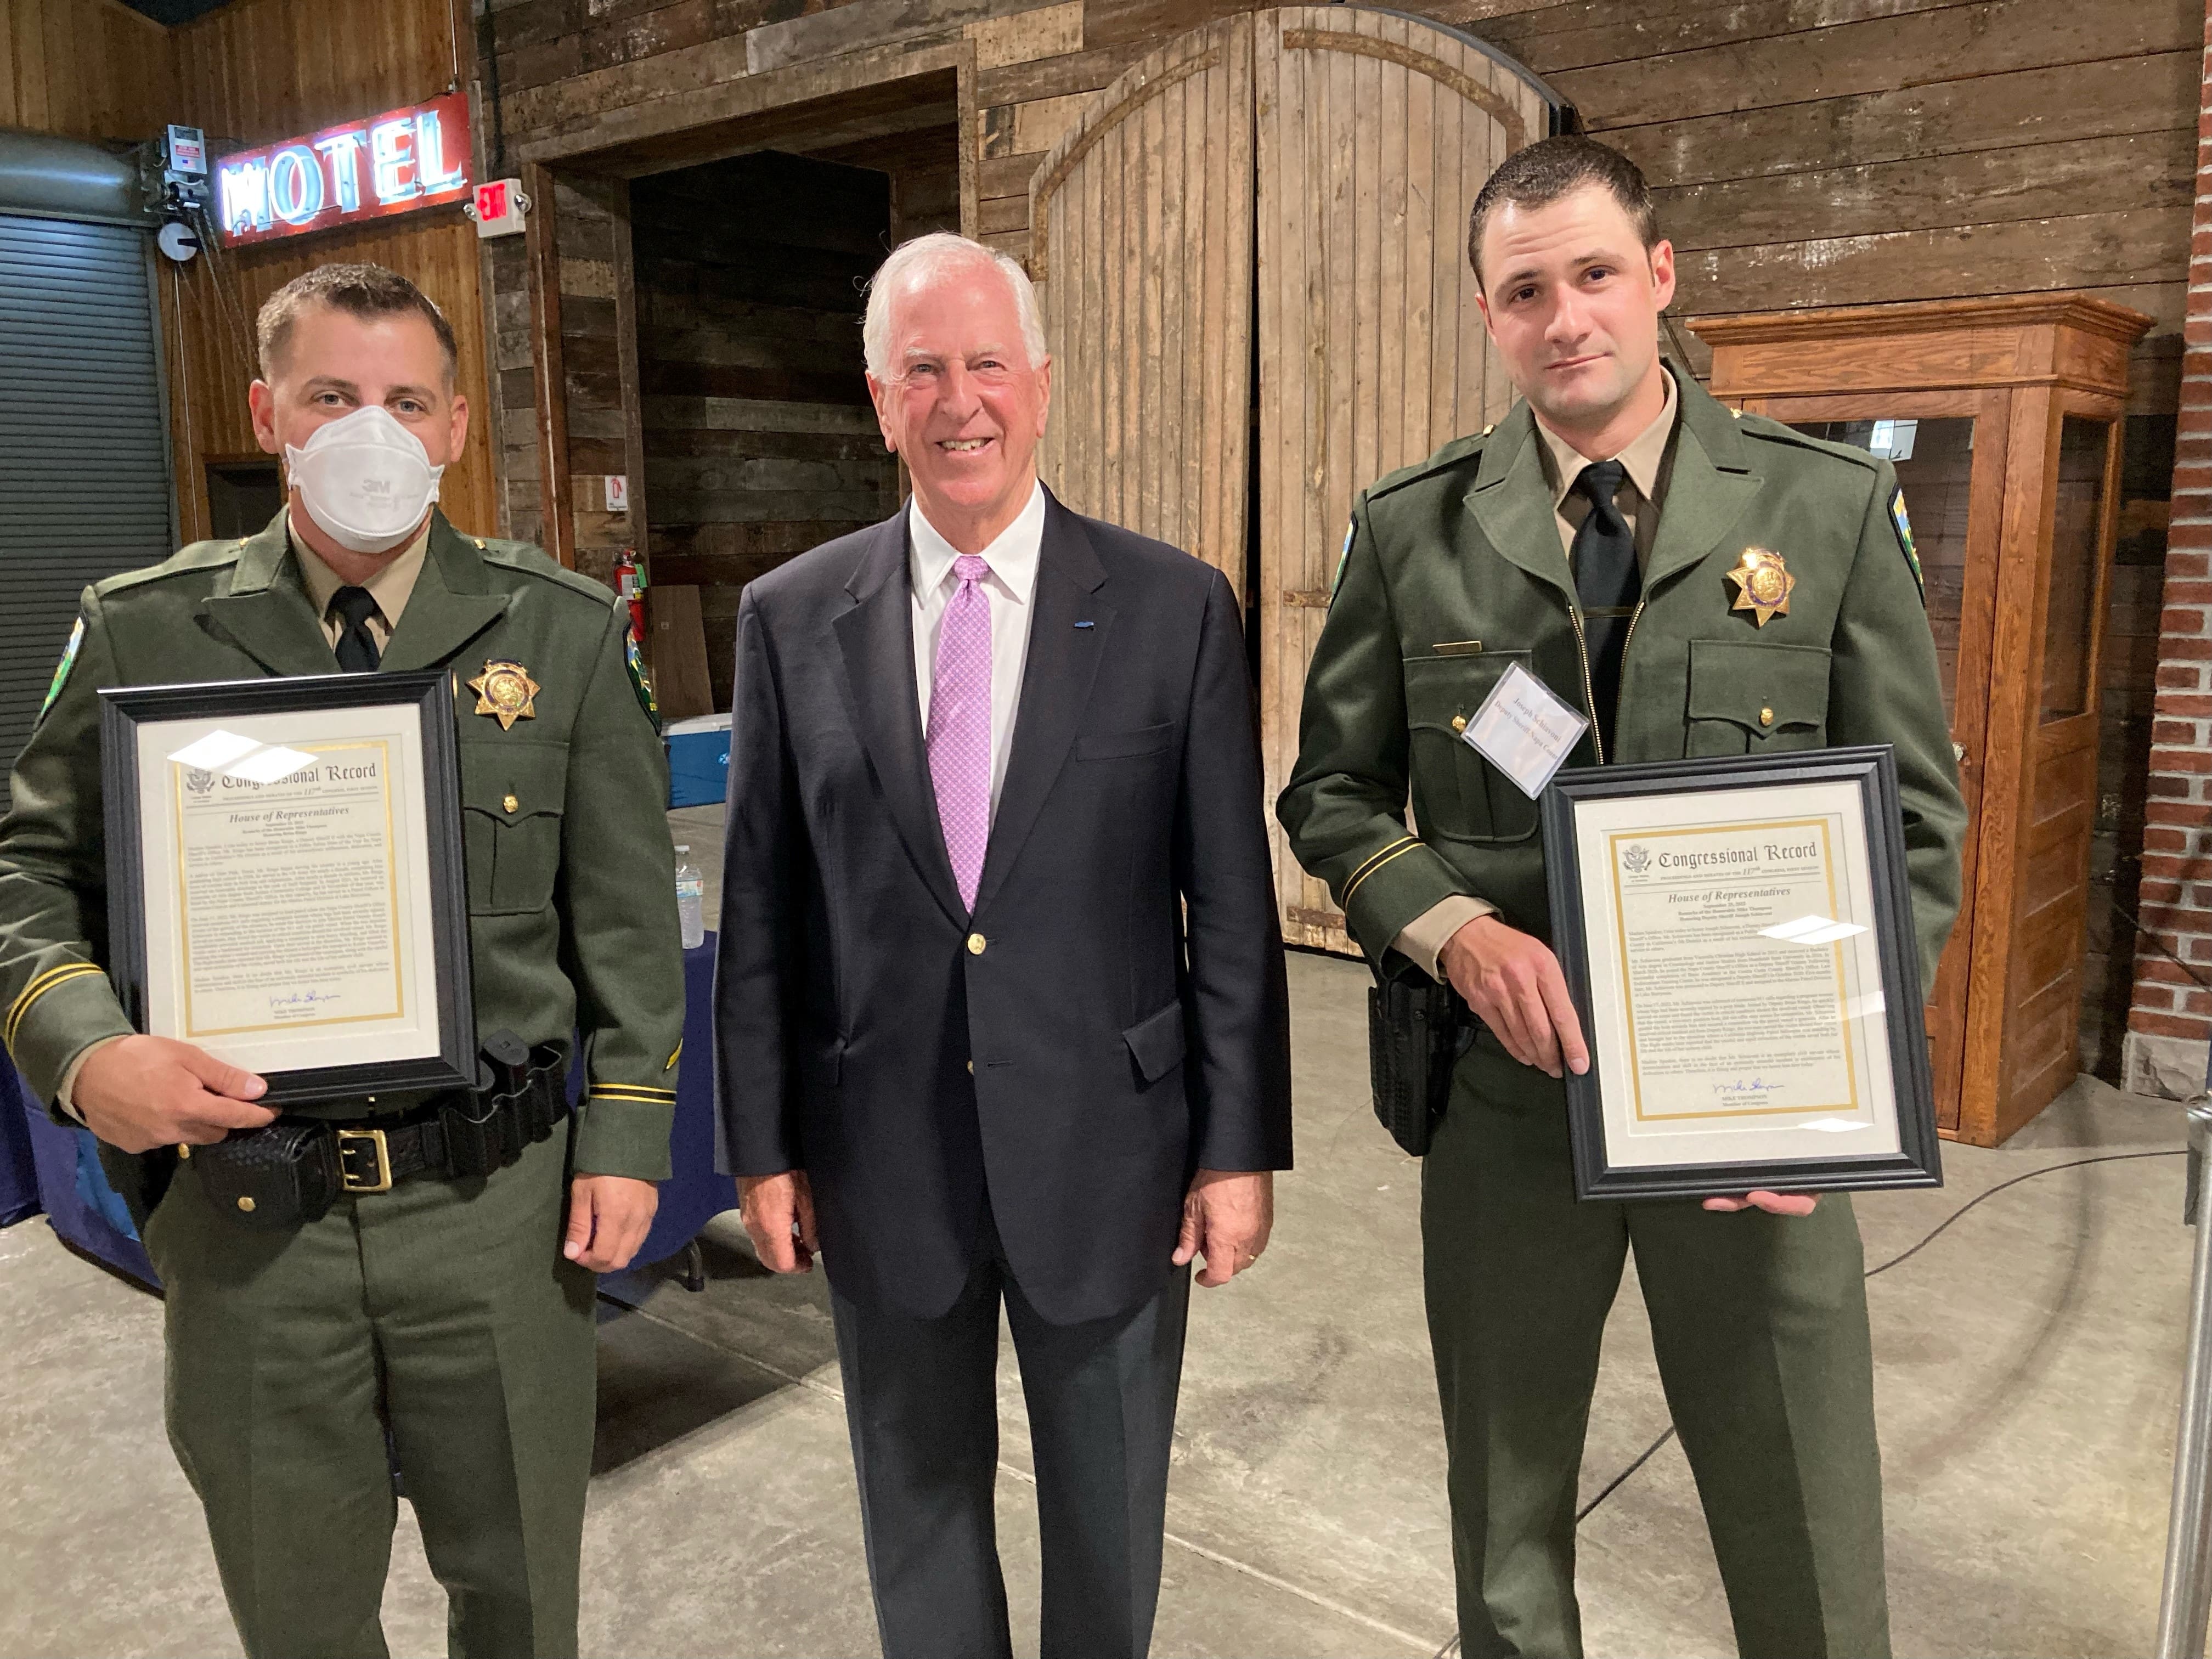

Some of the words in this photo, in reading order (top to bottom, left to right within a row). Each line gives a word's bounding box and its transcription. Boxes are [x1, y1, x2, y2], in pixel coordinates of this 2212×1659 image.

[221, 109, 467, 238] MOTEL
[362, 479, 391, 493] 3M
[1494, 701, 1513, 720] Deputy
[1513, 698, 1533, 718] Joseph
[1532, 714, 1562, 743] Schiavoni
[325, 763, 376, 781] Record
[229, 814, 260, 823] House
[263, 811, 274, 822] of
[276, 806, 349, 821] Representatives
[1658, 847, 1758, 870] Congressional
[1764, 842, 1817, 861] Record
[1668, 894, 1699, 903] House
[1702, 891, 1713, 902] of
[1715, 887, 1791, 901] Representatives
